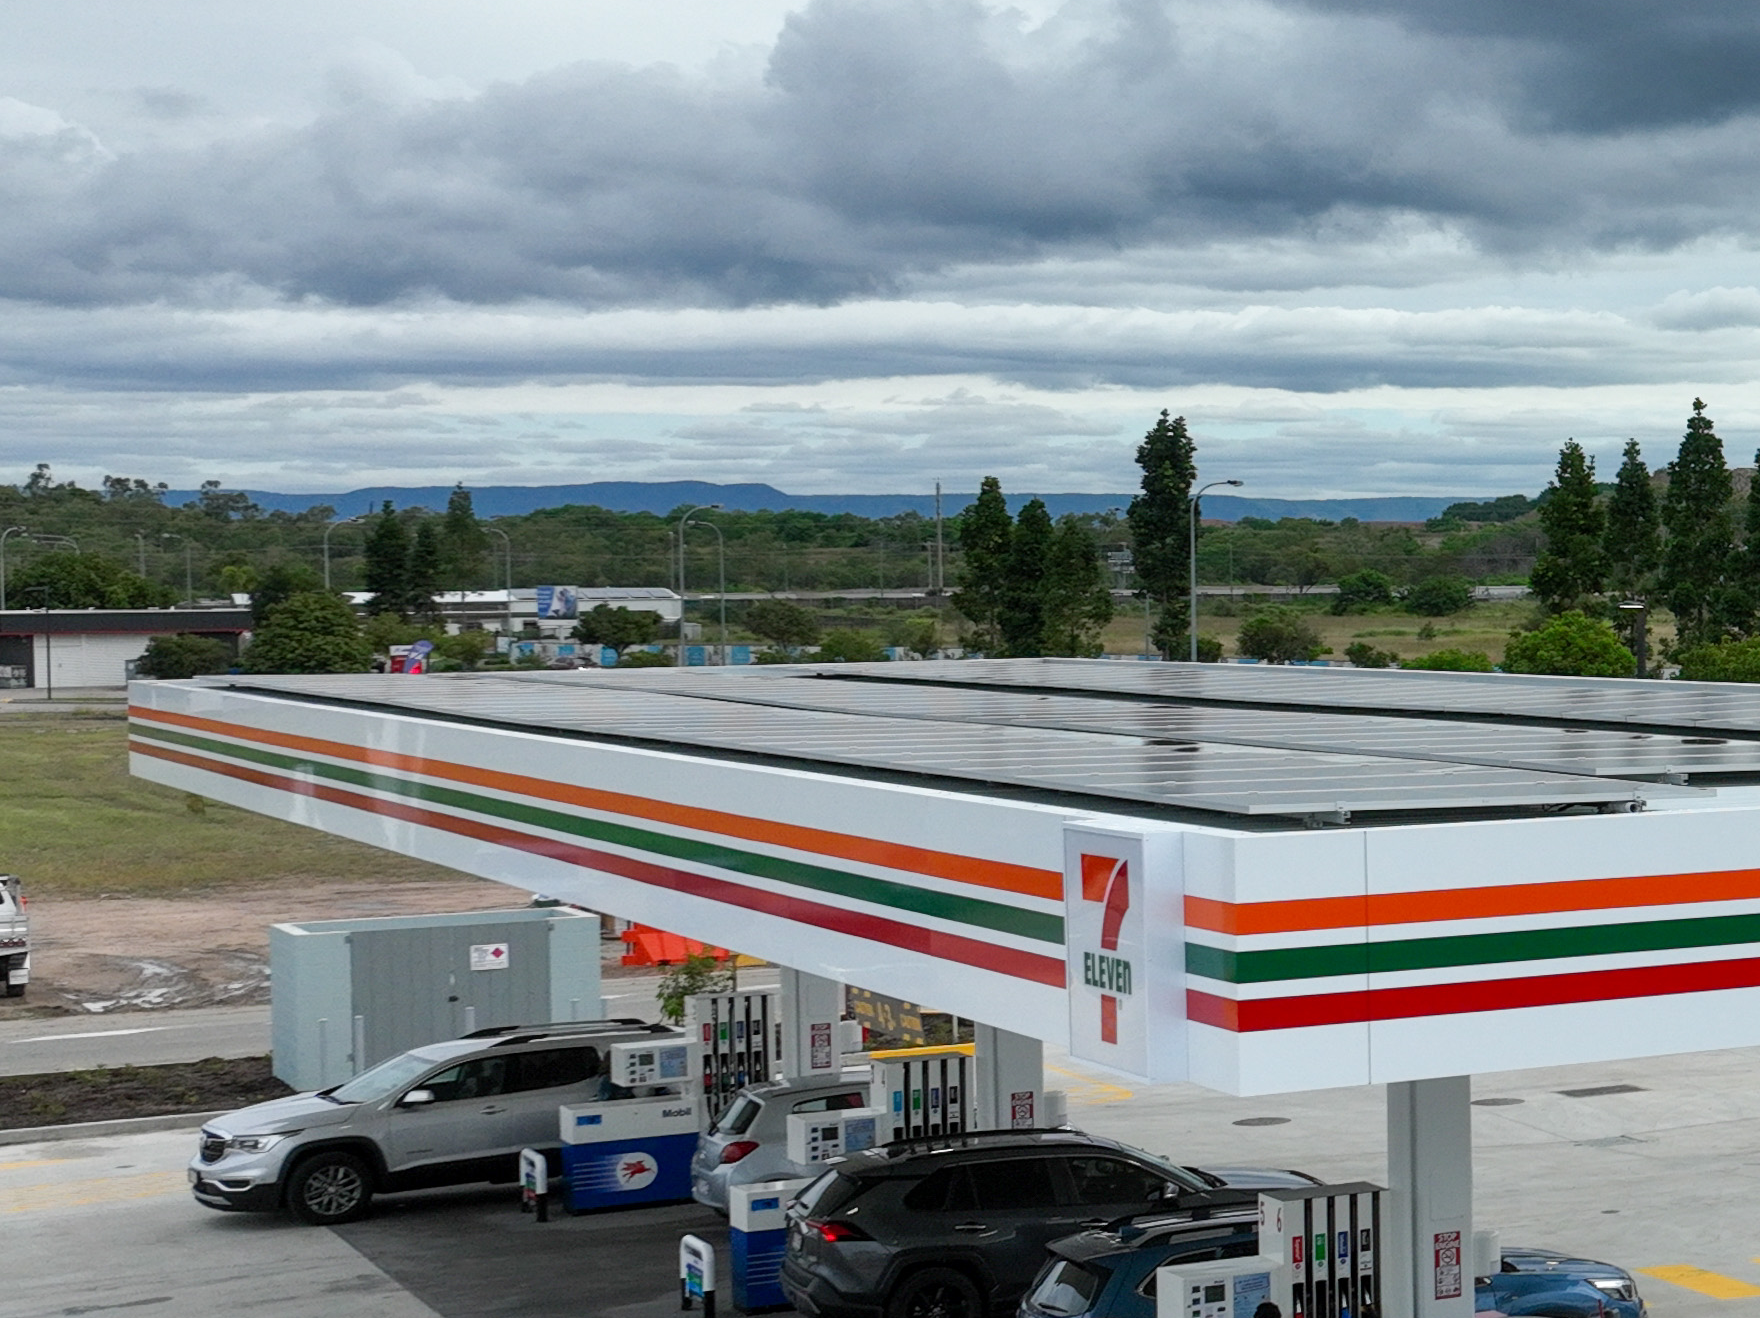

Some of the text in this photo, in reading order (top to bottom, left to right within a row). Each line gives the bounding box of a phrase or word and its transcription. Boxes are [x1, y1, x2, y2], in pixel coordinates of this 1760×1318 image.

[662, 1107, 692, 1118] Mobil
[1260, 1200, 1265, 1226] 5
[1276, 1207, 1282, 1232] 6
